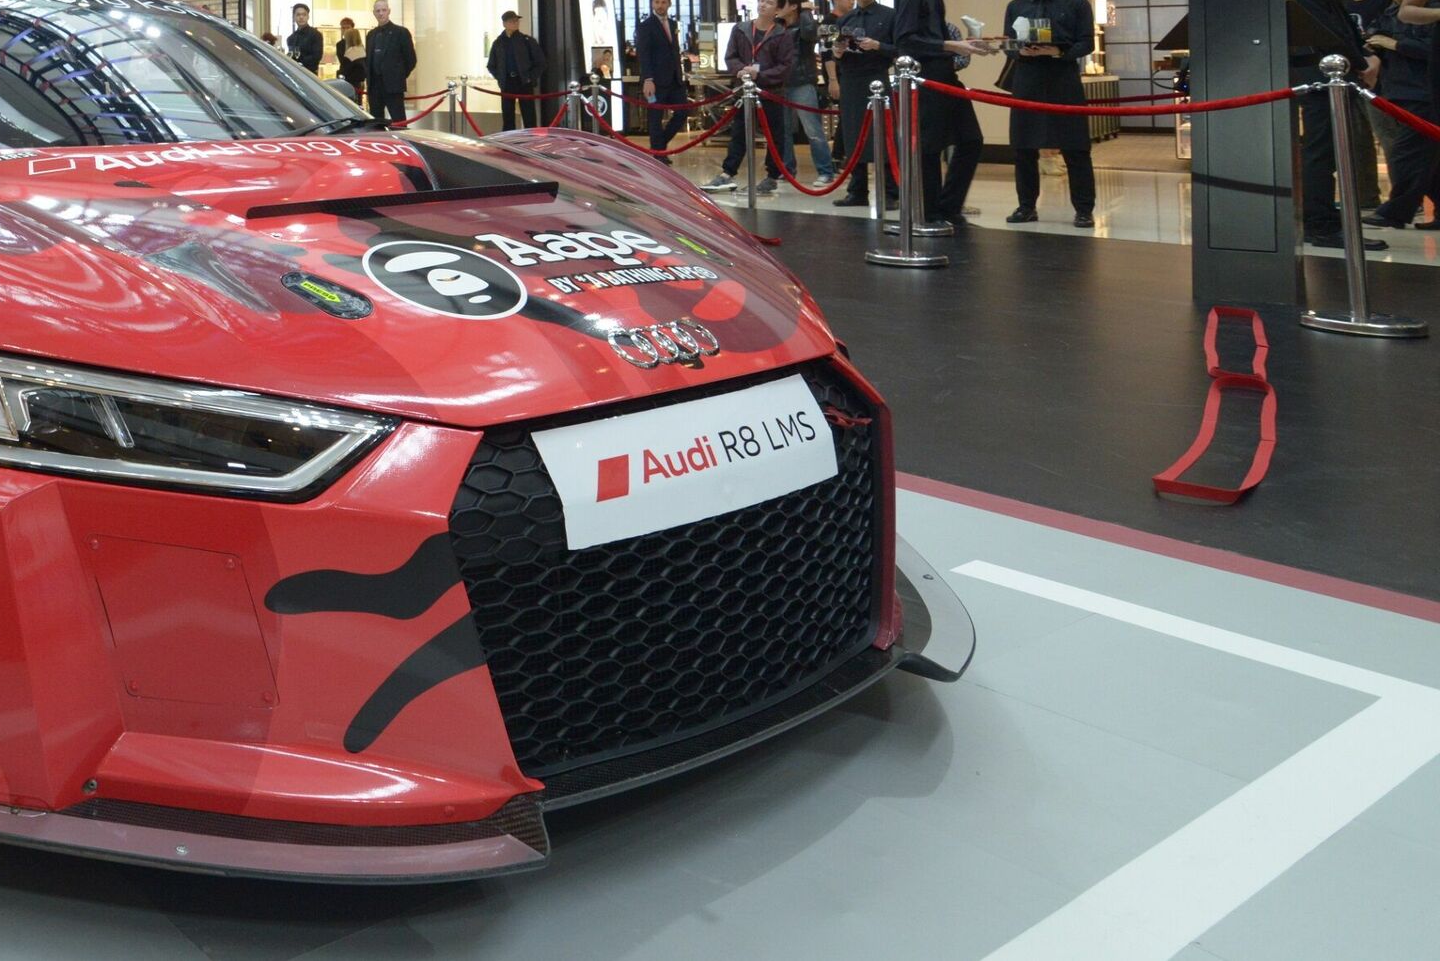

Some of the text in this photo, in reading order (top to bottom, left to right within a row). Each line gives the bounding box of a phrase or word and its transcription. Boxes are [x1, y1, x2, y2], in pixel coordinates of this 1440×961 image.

[95, 144, 208, 172] Audi
[217, 139, 342, 157] Hong
[475, 230, 673, 266] Aape
[548, 276, 581, 294] BY
[643, 411, 816, 484] Audi R8 LMS
